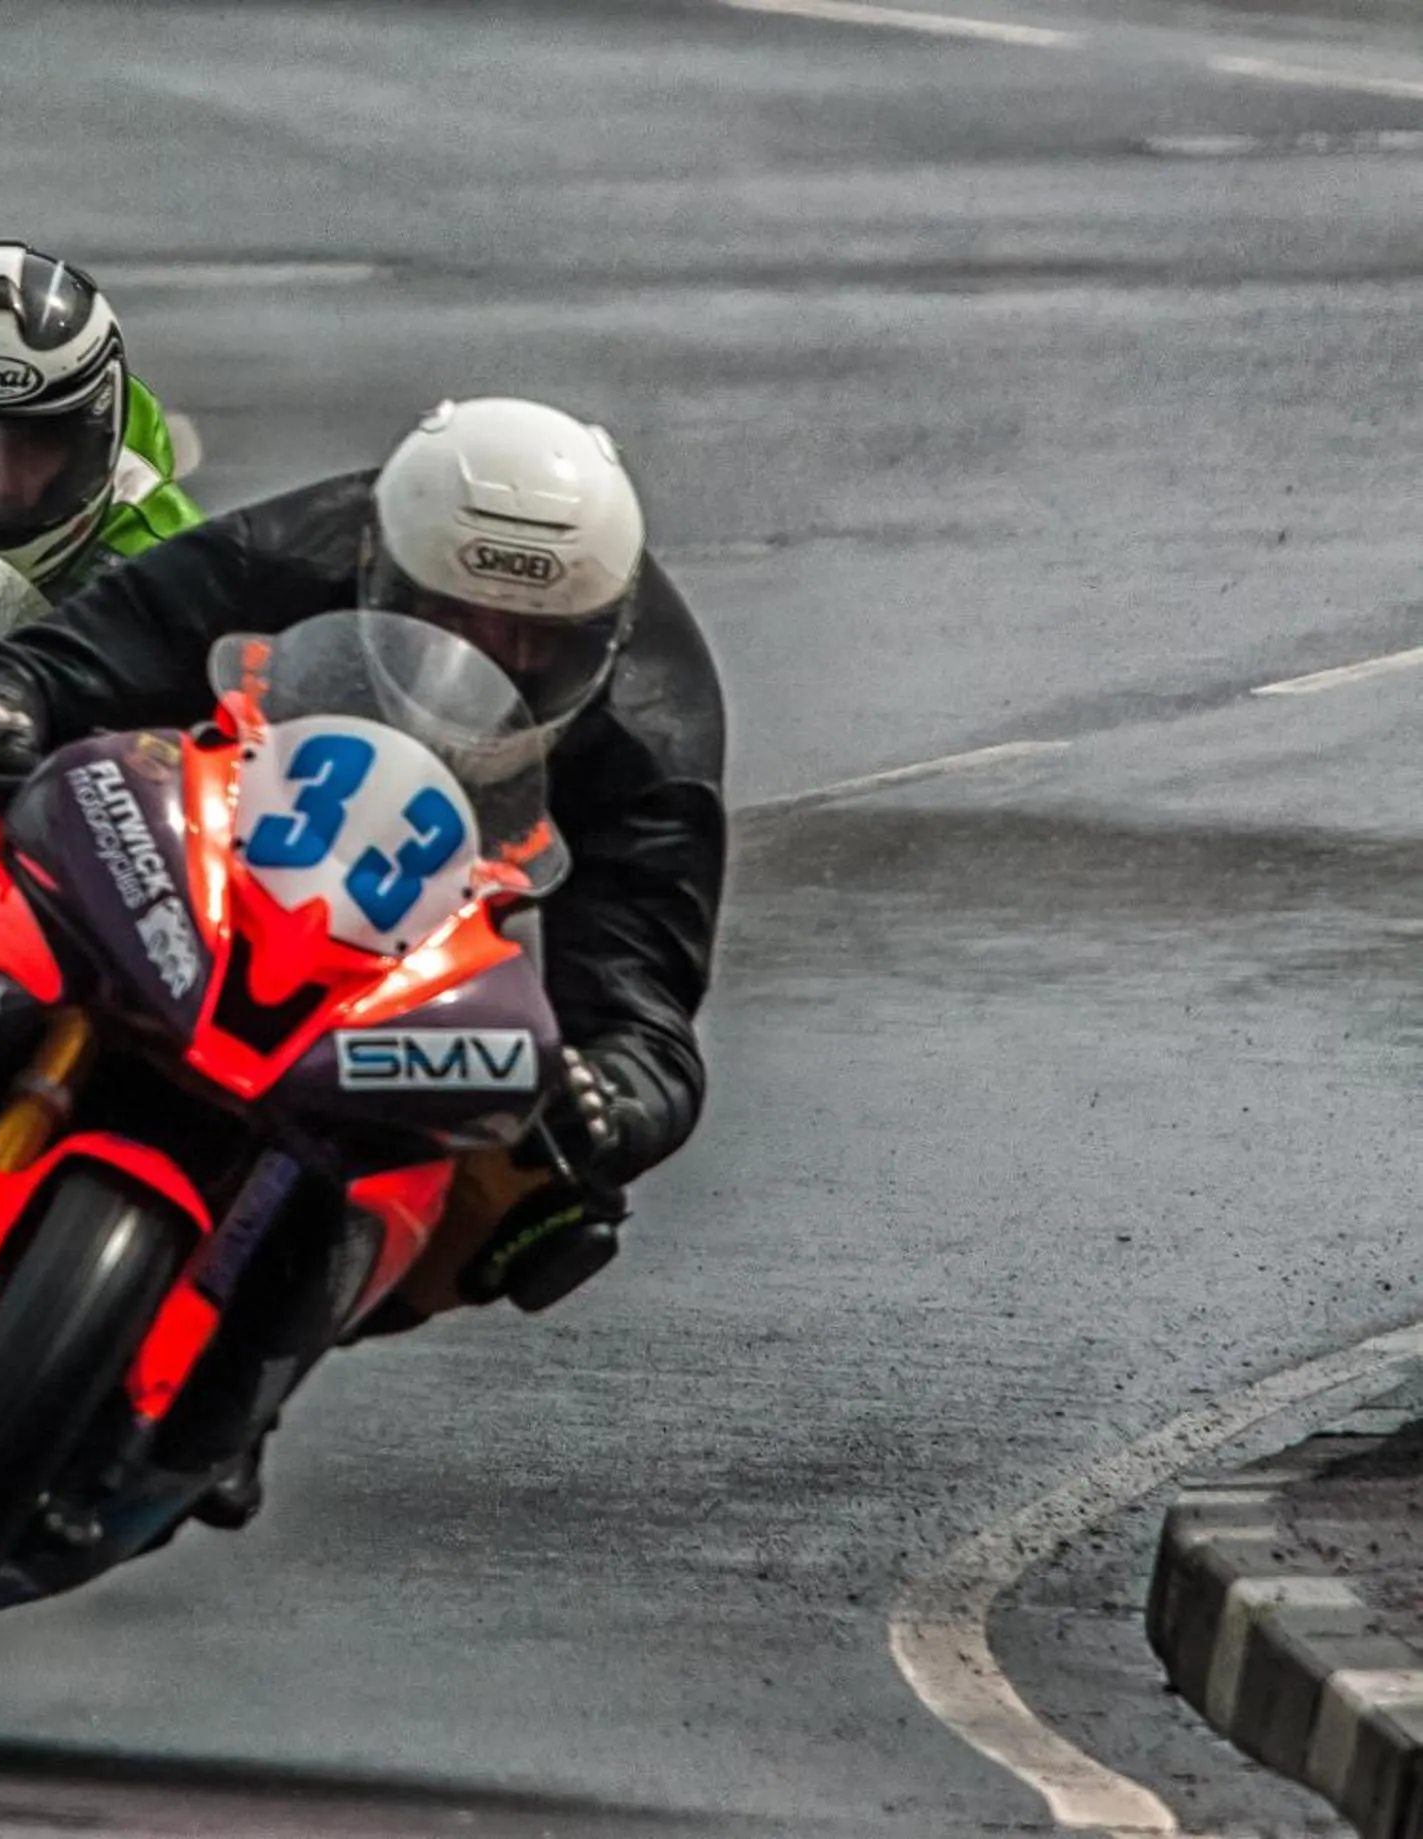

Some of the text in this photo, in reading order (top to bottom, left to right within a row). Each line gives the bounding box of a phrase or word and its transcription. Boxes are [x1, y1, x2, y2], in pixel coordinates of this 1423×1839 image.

[475, 546, 550, 580] SHOEI
[87, 759, 174, 901] FLITWICK
[247, 734, 466, 933] 33
[346, 1036, 524, 1079] SMV
